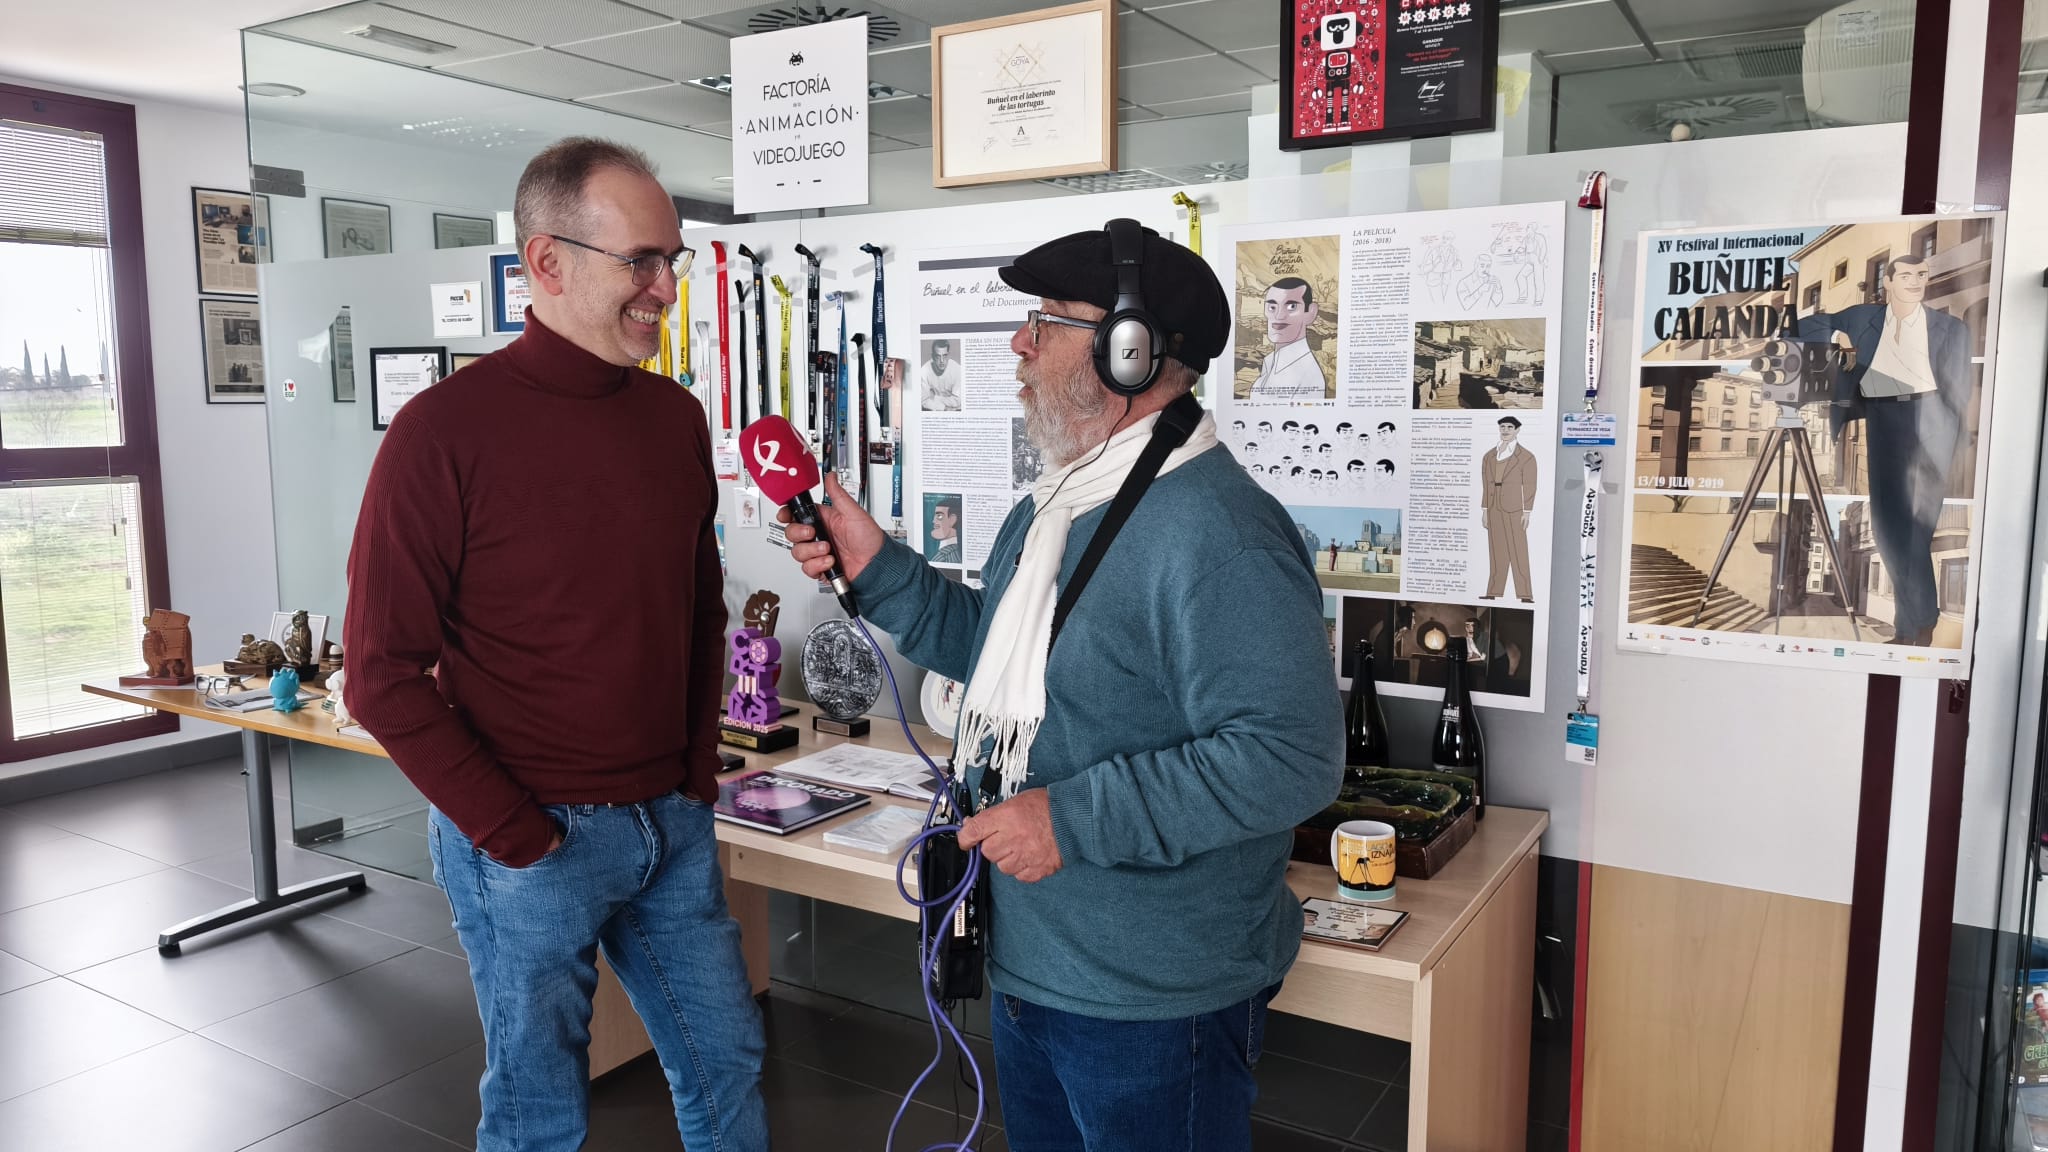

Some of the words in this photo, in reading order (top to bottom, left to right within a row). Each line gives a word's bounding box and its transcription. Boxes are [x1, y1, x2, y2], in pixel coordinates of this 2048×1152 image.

[763, 73, 831, 101] FACTORÍA
[987, 93, 1009, 105] Buñuel
[1019, 92, 1025, 101] el
[1026, 89, 1056, 100] laberinto
[998, 103, 1006, 111] de
[1007, 102, 1016, 110] las
[1017, 99, 1044, 110] tortugas
[753, 141, 845, 165] VIDEOJUEGO
[1364, 226, 1396, 236] PELÍCULA
[1658, 240, 1673, 253] XV
[1676, 237, 1719, 252] Festival
[1723, 232, 1804, 250] Internacional
[1668, 252, 1790, 296] BUÑUEL
[923, 282, 953, 297] Buñuel
[955, 287, 967, 295] en
[970, 281, 980, 294] el
[982, 297, 996, 307] Del
[1654, 303, 1800, 341] CALANDA
[1638, 475, 1666, 488] 13/19
[1668, 476, 1695, 489] JULIO
[1698, 477, 1724, 489] 2019
[755, 775, 856, 798] DECORADO
